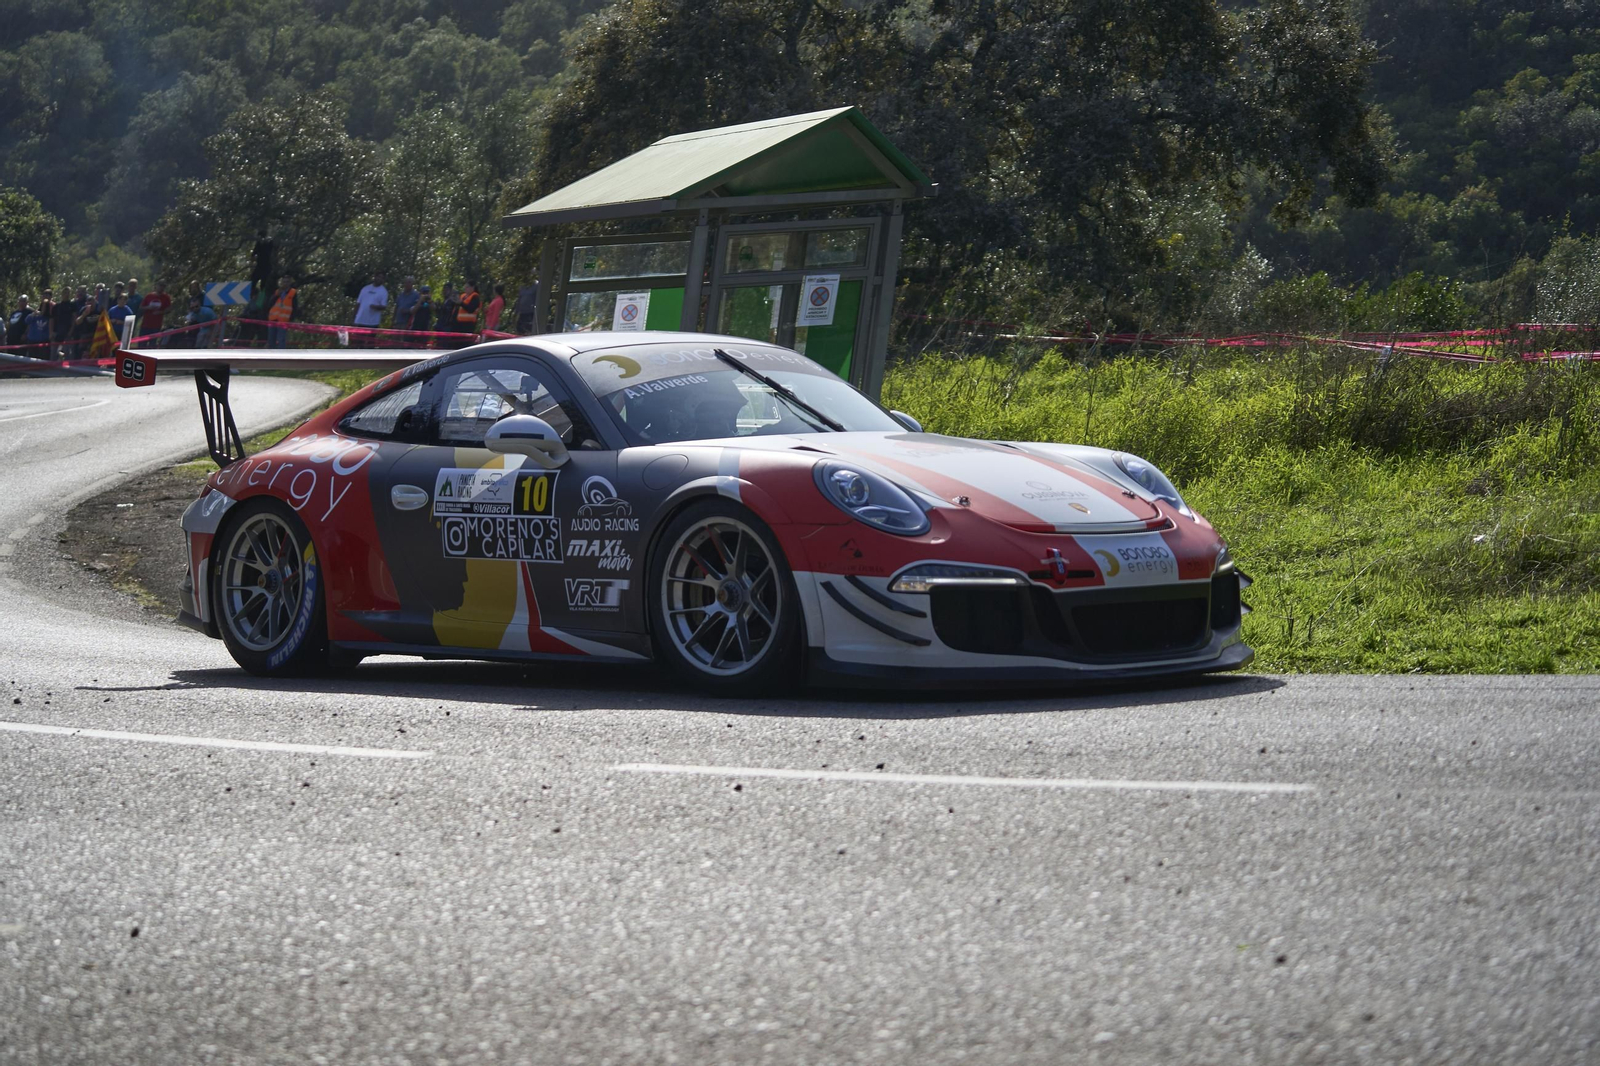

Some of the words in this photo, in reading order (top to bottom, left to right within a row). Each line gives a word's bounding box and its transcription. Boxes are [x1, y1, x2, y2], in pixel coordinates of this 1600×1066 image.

[122, 358, 146, 381] 99
[216, 459, 353, 522] energy
[521, 475, 548, 513] 10
[479, 503, 511, 514] Villacor
[467, 517, 558, 540] MORENO'S
[570, 518, 601, 531] AUDIO
[604, 518, 640, 532] RACING
[482, 537, 556, 560] CAPILAR
[1127, 560, 1174, 574] energy
[564, 578, 630, 606] VRT
[271, 587, 314, 667] MICHELIN
